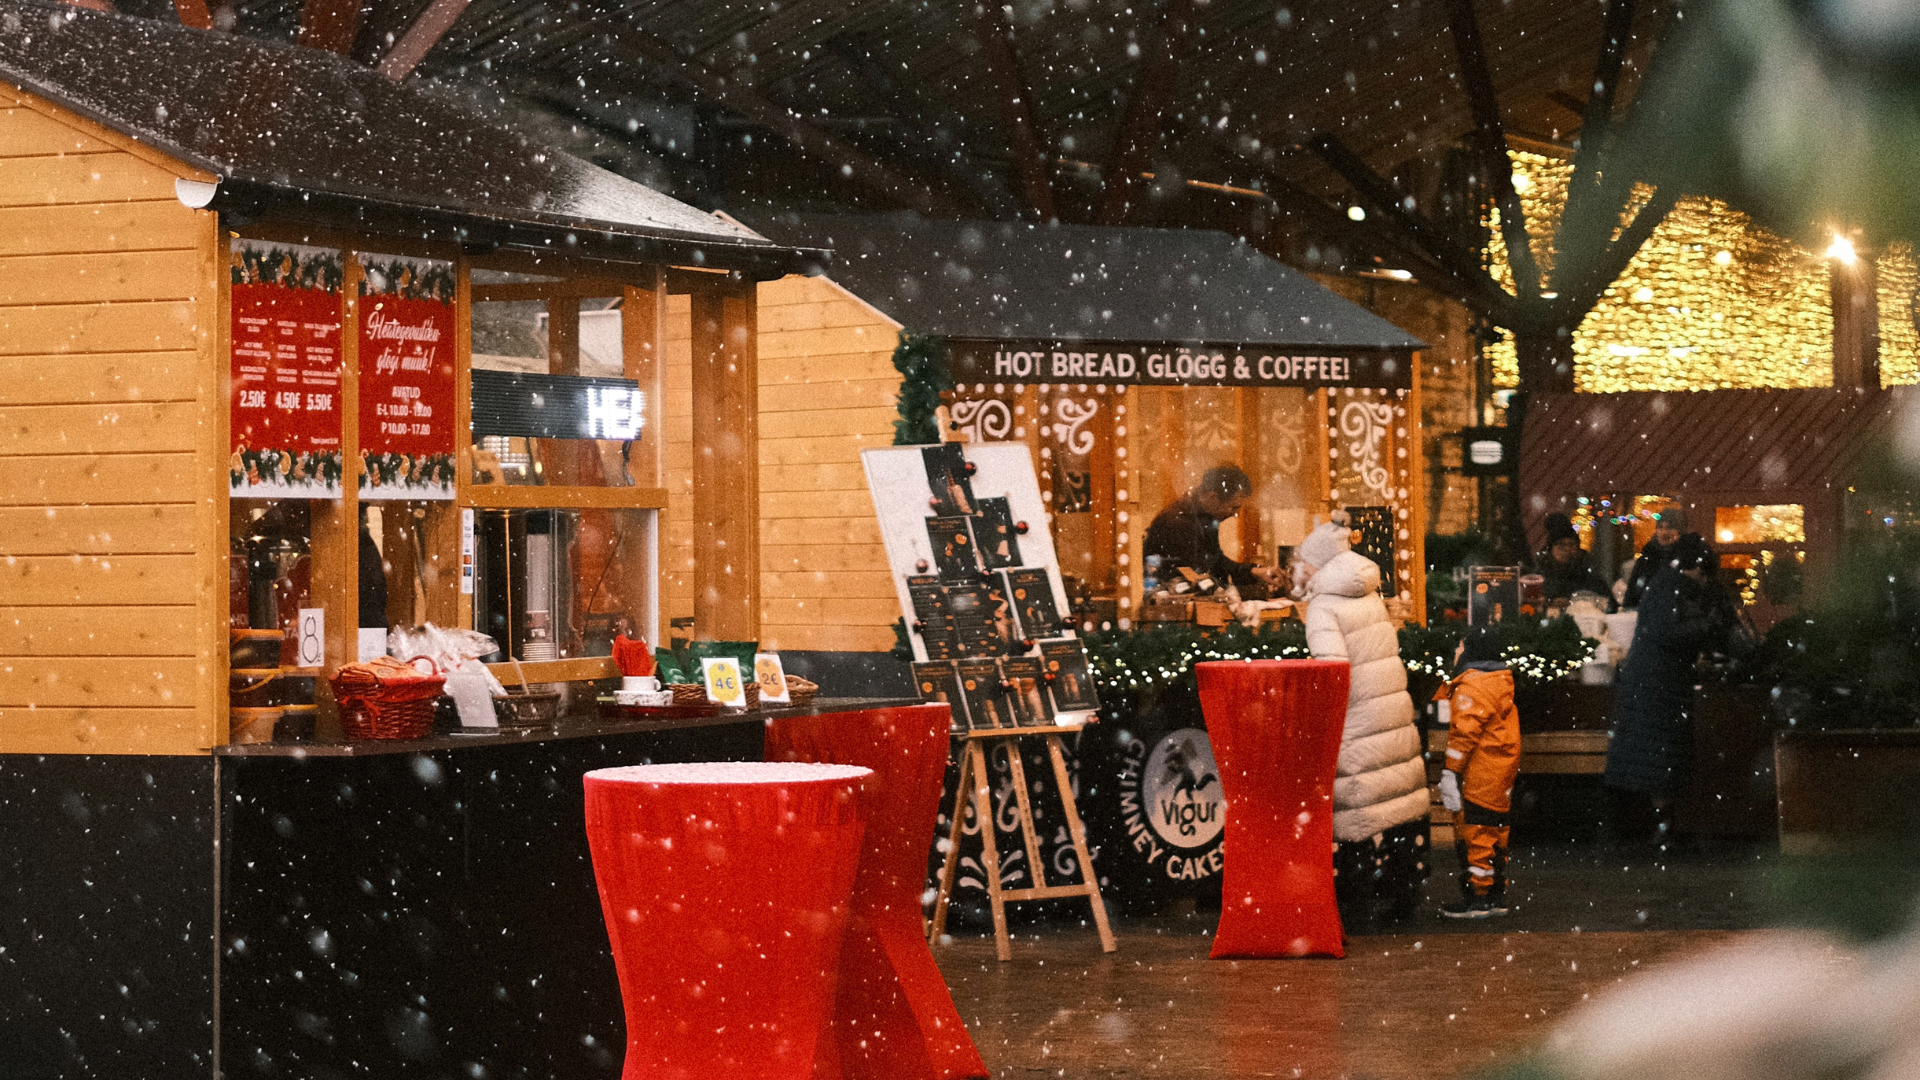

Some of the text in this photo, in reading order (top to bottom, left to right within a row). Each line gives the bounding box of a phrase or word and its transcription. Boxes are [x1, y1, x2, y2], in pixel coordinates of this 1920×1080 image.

[995, 347, 1350, 381] HOT BREAD, GLÖGG & COFFEE!
[392, 385, 421, 399] AVATUD
[239, 390, 333, 411] 2.50€ 4.50€ 5.50€
[389, 404, 409, 417] 10.00
[381, 421, 388, 434] P
[387, 422, 407, 435] 10.00
[715, 676, 735, 690] 4€
[761, 672, 779, 686] 2€
[1119, 738, 1164, 865] CHIMNEY
[1161, 799, 1219, 837] Vigur
